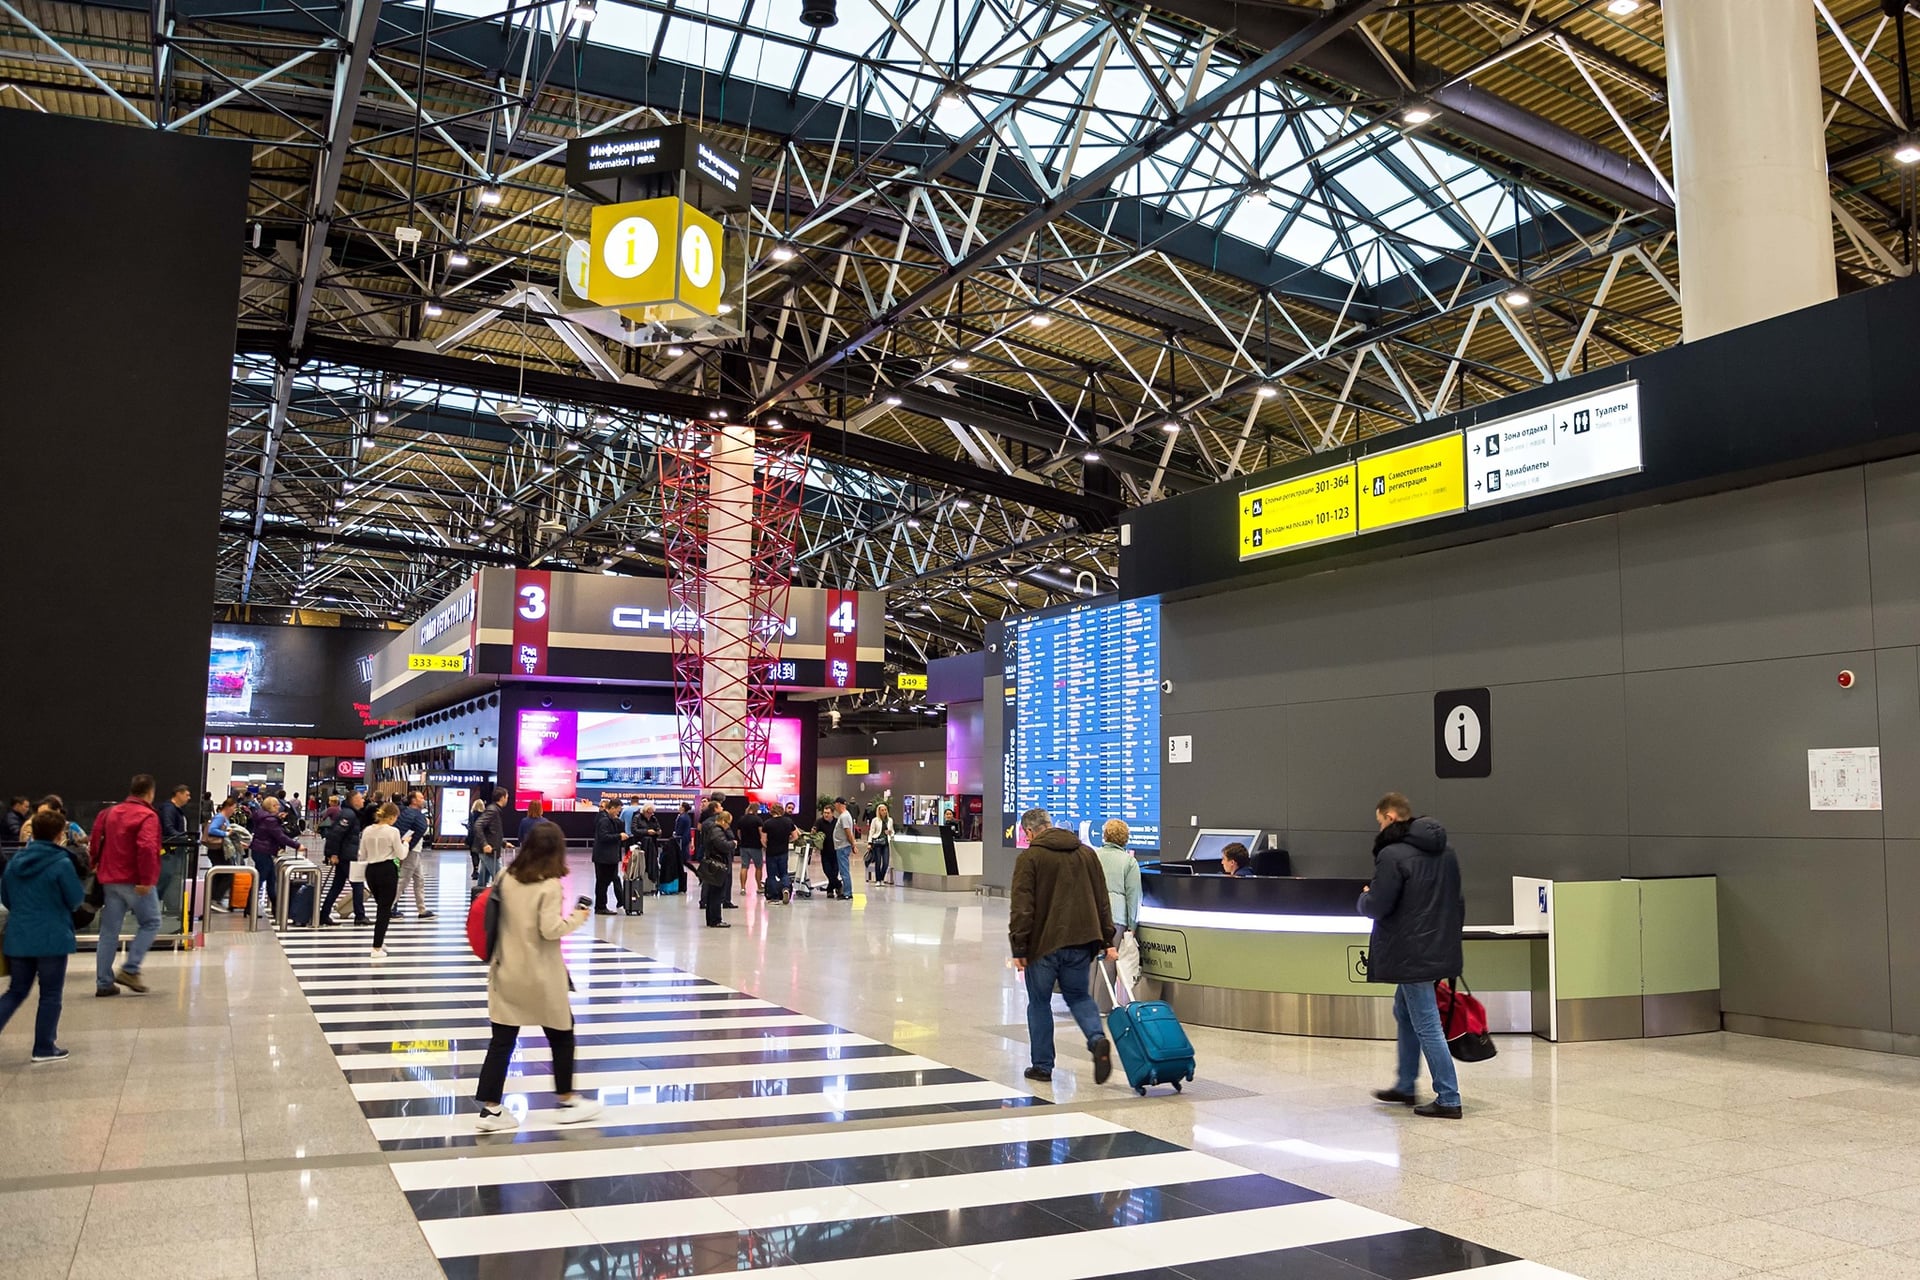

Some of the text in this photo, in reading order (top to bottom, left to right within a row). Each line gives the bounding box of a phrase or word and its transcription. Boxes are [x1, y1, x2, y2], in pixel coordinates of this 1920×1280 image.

[590, 139, 660, 157] Информация
[589, 158, 629, 170] Information
[1595, 403, 1628, 418] Туалеты
[1503, 424, 1548, 442] Зона отдыха
[1388, 461, 1442, 480] Самостоятельная
[1505, 460, 1550, 477] Авиабилеты
[1315, 474, 1349, 494] 301-364
[1388, 477, 1427, 493] регистрация
[1316, 507, 1349, 525] 101-123
[519, 585, 546, 620] 3
[829, 601, 856, 633] 4
[413, 658, 432, 668] 333
[441, 659, 460, 669] 348
[901, 678, 917, 687] 349
[235, 740, 293, 752] 101-123
[1171, 740, 1175, 751] 3
[429, 774, 484, 783] wrapping point
